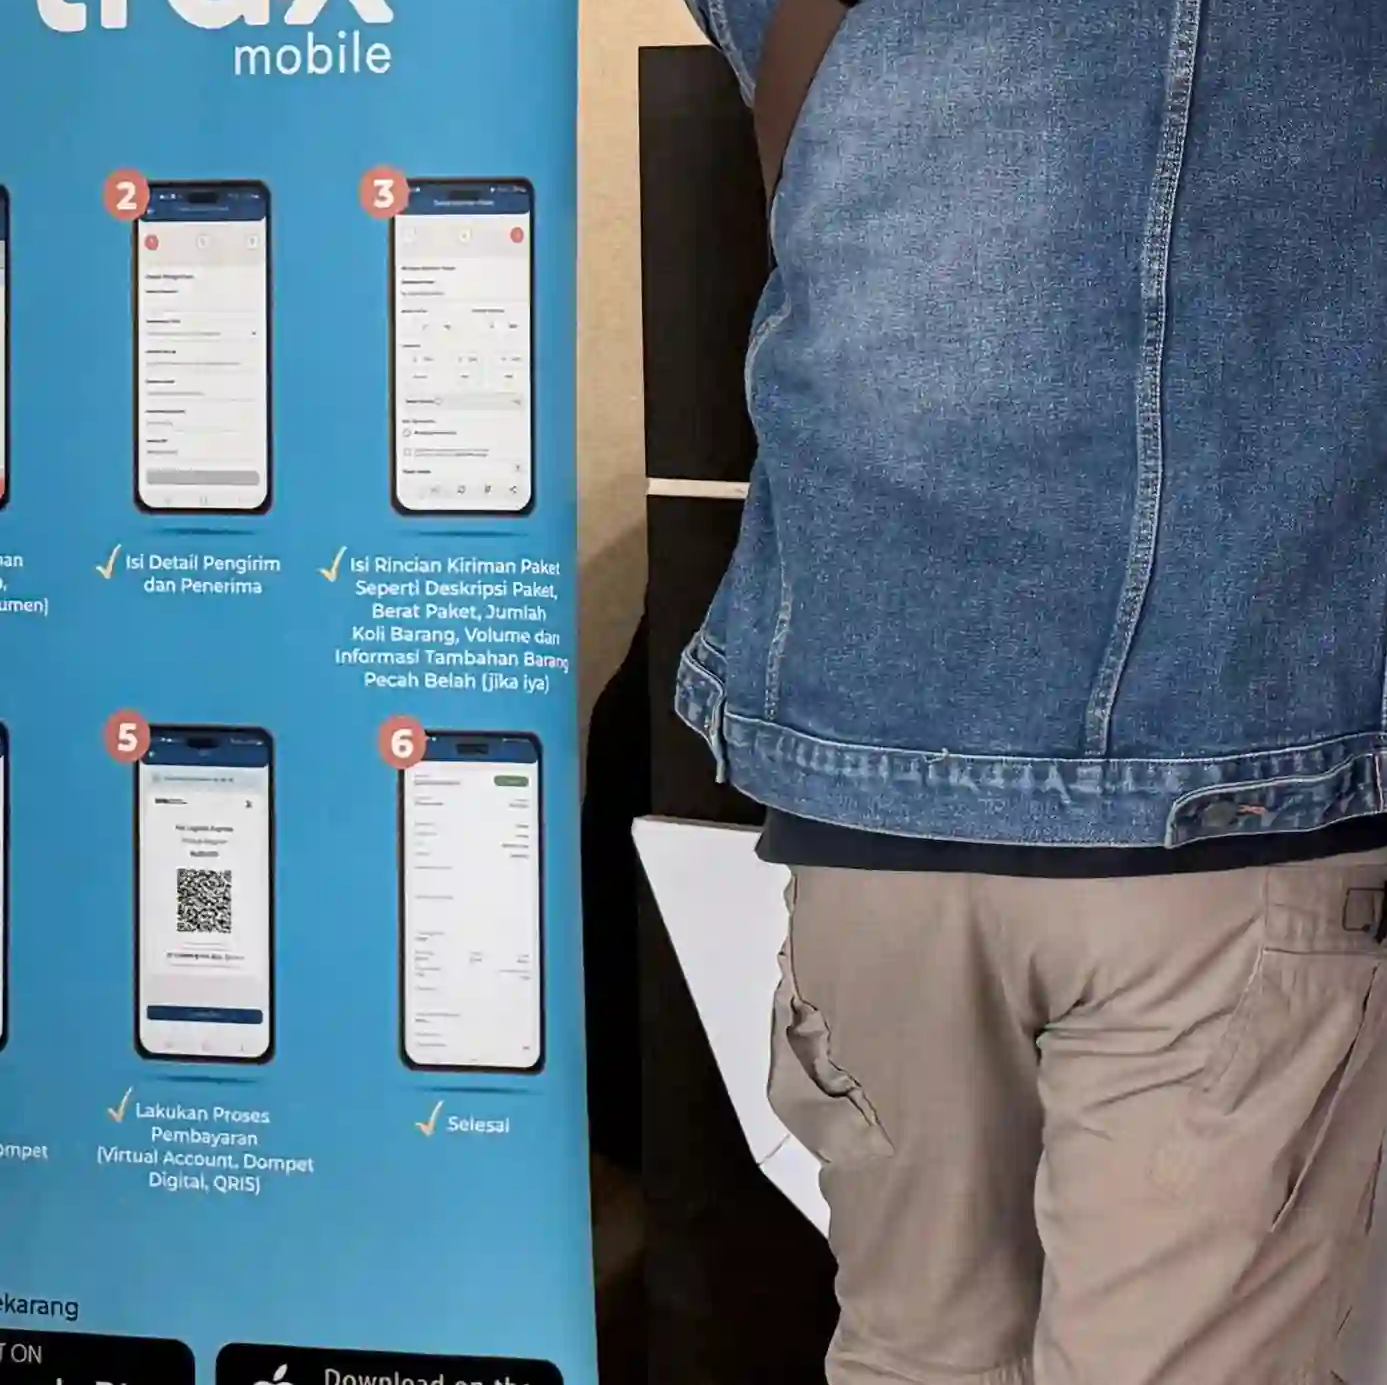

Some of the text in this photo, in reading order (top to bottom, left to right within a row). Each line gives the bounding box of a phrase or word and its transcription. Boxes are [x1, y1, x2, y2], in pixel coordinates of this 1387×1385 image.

[234, 31, 391, 76] mobile
[116, 182, 137, 211] 2
[373, 179, 395, 208] 3
[126, 554, 281, 574] Isi Detail Pengirim
[351, 556, 560, 576] Isi Rincian Kiriman Paket
[144, 577, 262, 594] dan Penerima
[355, 580, 558, 600] Seperti Deskripsi Paket,
[372, 604, 547, 621] Berat Paket, Jumlah
[352, 626, 560, 646] Koli Barang, Volume dan
[335, 649, 569, 674] Informasi Tambahan Barang
[364, 671, 549, 694] Pecah Belah (jika iya)
[118, 723, 138, 752] 5
[391, 729, 414, 759] 6
[136, 1103, 270, 1123] Lakukan Proses
[447, 1116, 510, 1133] Selesai
[152, 1127, 258, 1147] Pembayaran
[97, 1146, 314, 1174] (Virtual Account, Dompet
[149, 1172, 261, 1196] Digital, QRIS)
[0, 1293, 79, 1322] karang
[11, 1343, 42, 1365] ON
